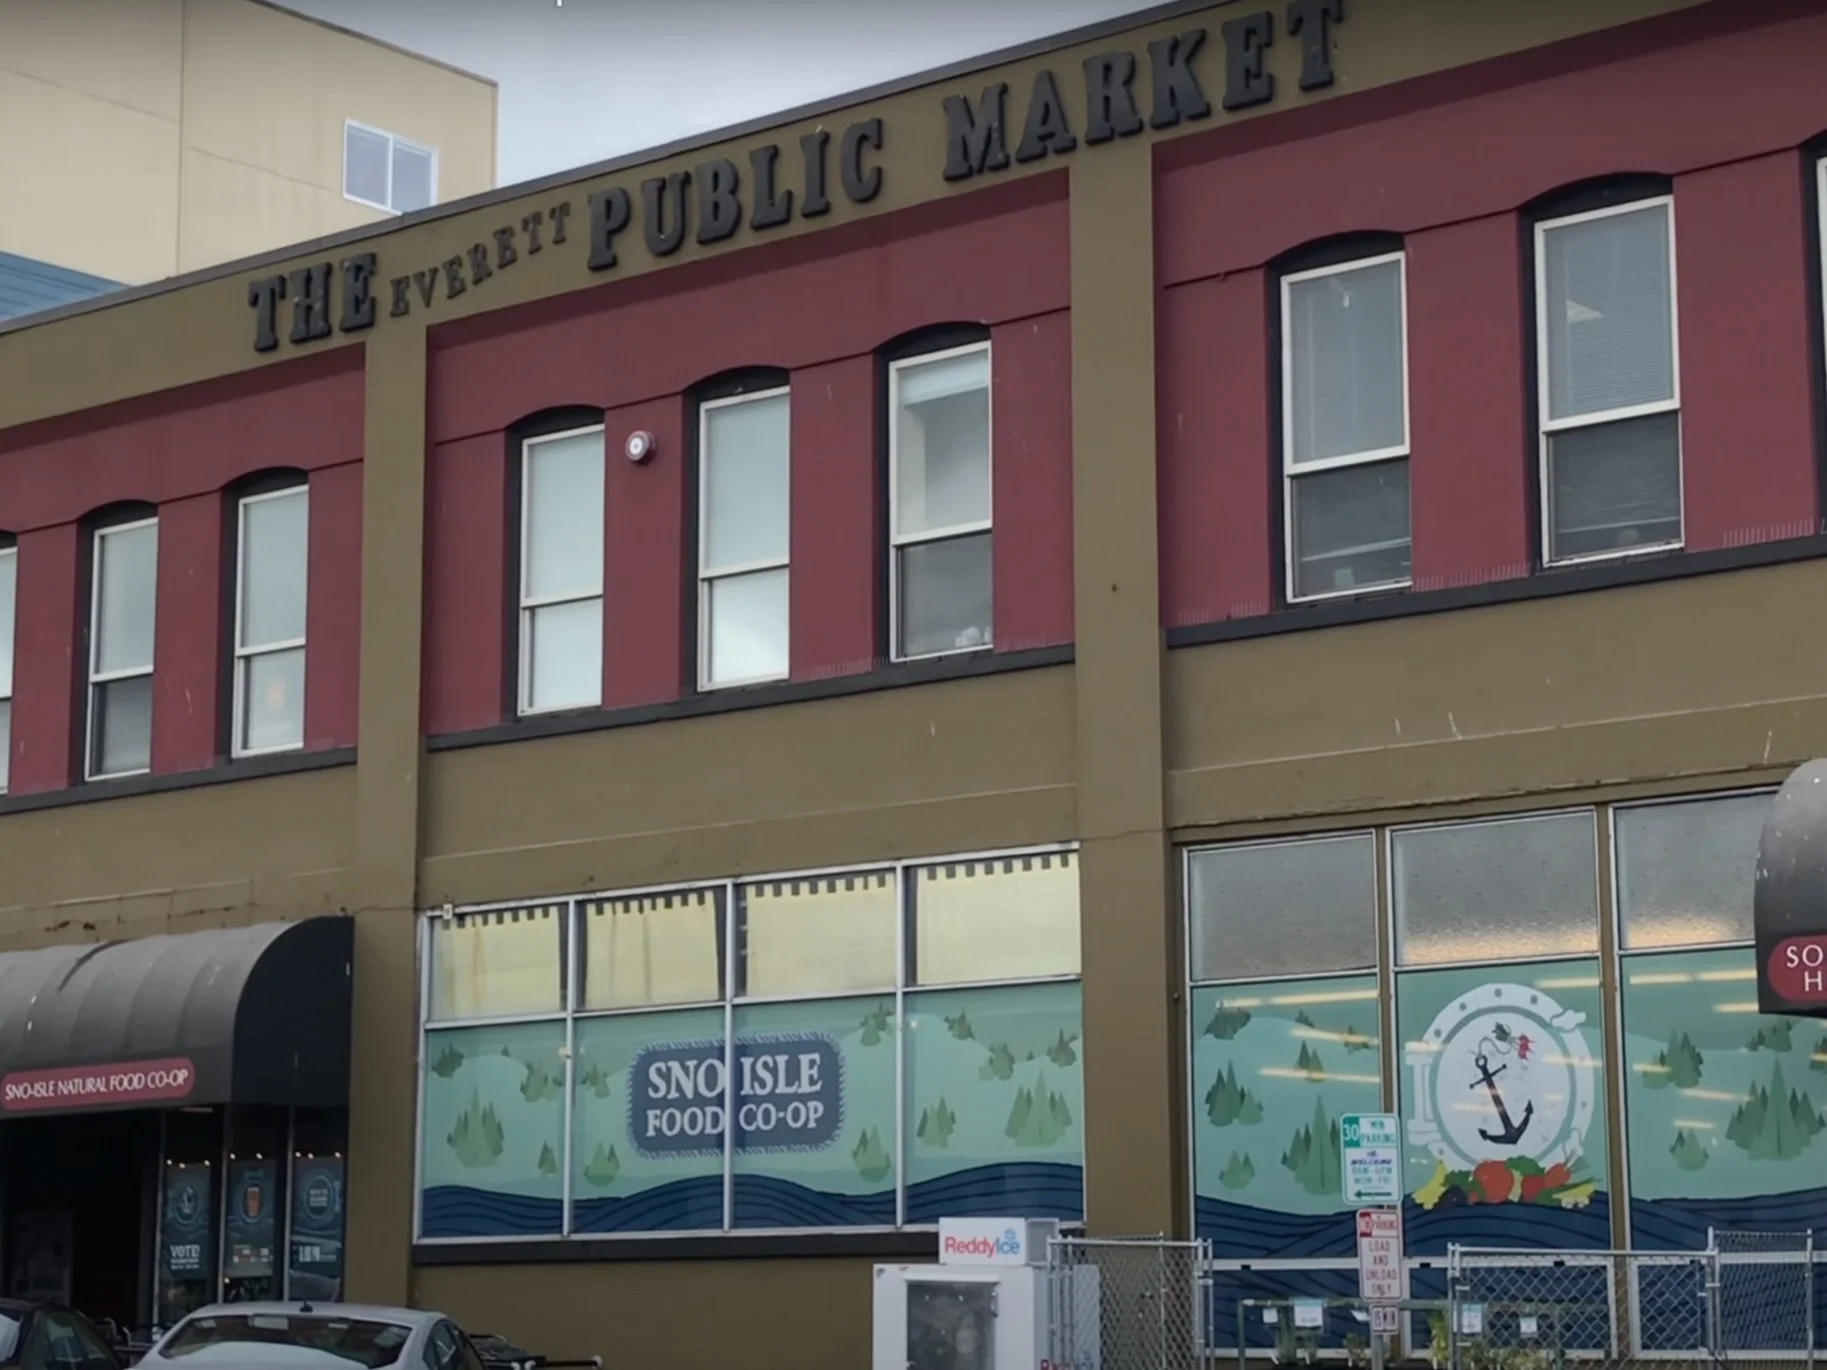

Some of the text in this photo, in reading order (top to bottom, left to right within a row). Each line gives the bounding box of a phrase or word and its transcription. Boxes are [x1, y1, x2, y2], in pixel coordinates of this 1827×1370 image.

[248, 0, 1343, 353] THE EVERETT PUBLIC MARKET
[5, 1068, 188, 1101] SNO-ISLE NATURAL FOOD CO-OP
[648, 1053, 823, 1100] SNO ISLE
[645, 1101, 824, 1137] FOOD CO-OP
[1343, 1123, 1359, 1141] 30
[1369, 1241, 1391, 1252] LOAD
[1373, 1255, 1389, 1266] AND
[1366, 1269, 1397, 1281] UNLOAD
[1371, 1284, 1392, 1295] ONLY
